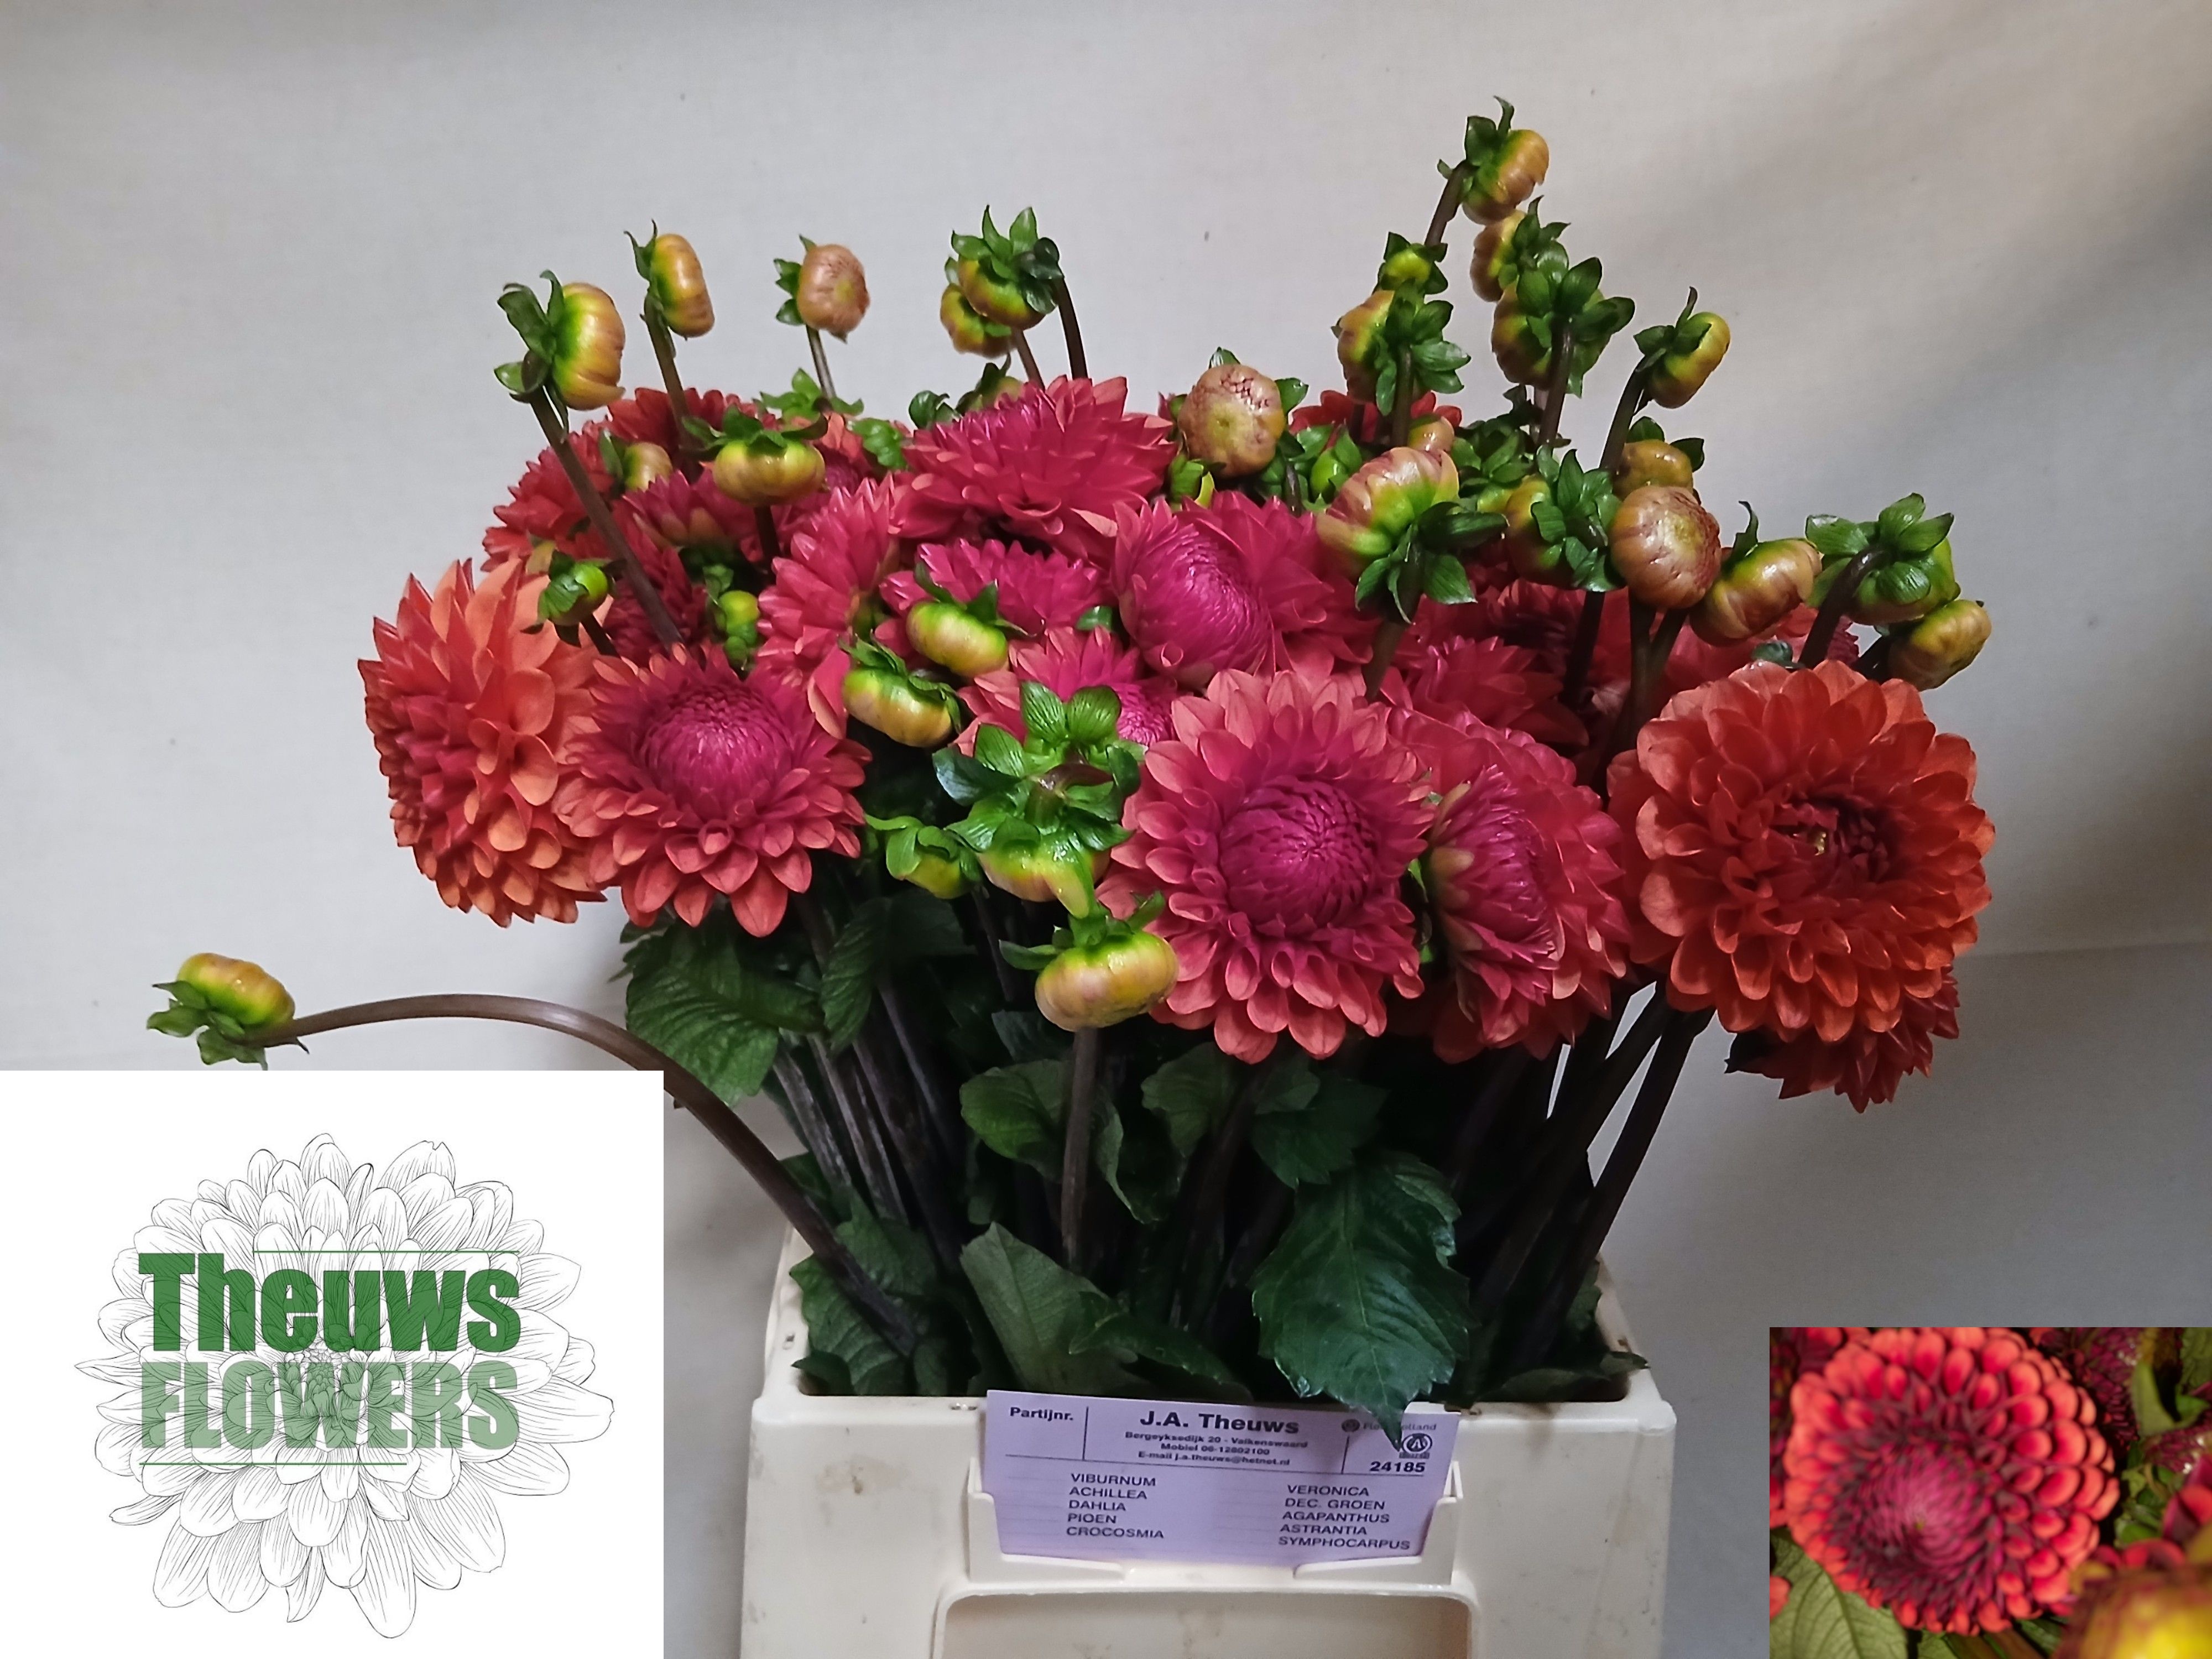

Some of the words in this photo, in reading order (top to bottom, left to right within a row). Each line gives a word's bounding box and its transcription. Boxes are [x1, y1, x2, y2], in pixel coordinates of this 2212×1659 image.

[1010, 1407, 1074, 1421] Partijnr.
[1140, 1411, 1189, 1427] J.A.
[1199, 1413, 1300, 1434] Theuws
[1161, 1443, 1198, 1451] Mobiel
[1231, 1437, 1308, 1448] Valkenswaard
[1138, 1451, 1172, 1459] E-mail
[1369, 1461, 1426, 1473] 24185
[1071, 1473, 1156, 1487] VIBURNUM
[1069, 1486, 1147, 1500] ACHILLEA
[1287, 1485, 1369, 1496] VERONICA
[1068, 1500, 1126, 1511] DAHLIA
[1285, 1498, 1322, 1509] DEC.
[1328, 1500, 1385, 1510] GROEN
[1067, 1513, 1117, 1524] PIOEN
[1282, 1511, 1390, 1523] AGAPANTHUS
[1066, 1527, 1164, 1538] CROCOSMIA
[1280, 1524, 1368, 1535] ASTRANTIA
[1278, 1536, 1410, 1550] SYMPHOCARPUS
